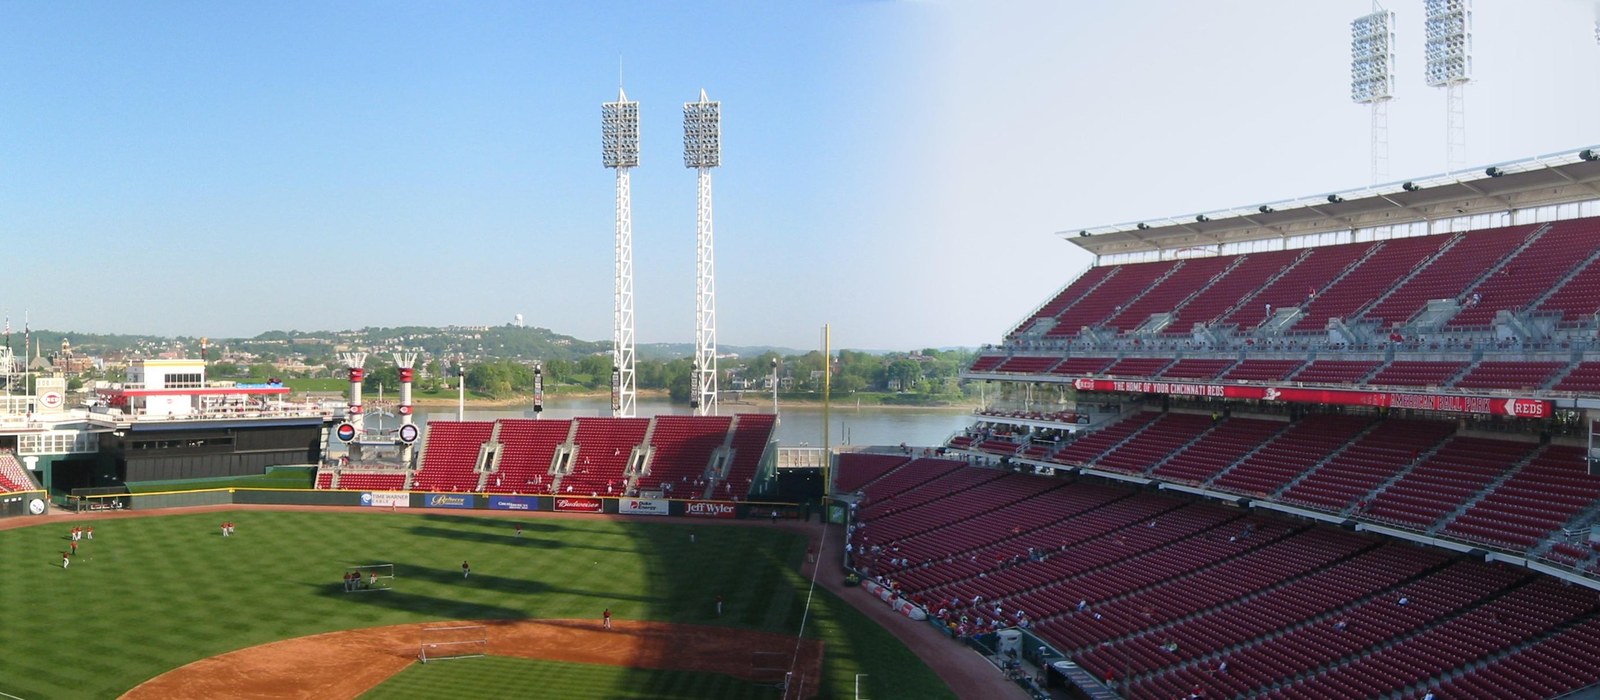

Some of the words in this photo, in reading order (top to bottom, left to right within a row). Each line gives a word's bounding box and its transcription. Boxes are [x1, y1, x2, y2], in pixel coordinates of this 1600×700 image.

[1113, 381, 1125, 391] THE
[1126, 382, 1142, 392] HOME
[1143, 382, 1151, 392] OF
[1153, 383, 1169, 393] YOUR
[1170, 383, 1206, 395] CINCINNATI
[1207, 385, 1224, 397] REDS
[1390, 393, 1435, 410] AMERICAN
[1437, 395, 1462, 412] BALL
[1464, 397, 1491, 413] PARK
[1515, 403, 1543, 415] REDS
[557, 499, 600, 509] Budweiser
[685, 502, 705, 513] Jeff
[706, 503, 734, 514] Wyler
